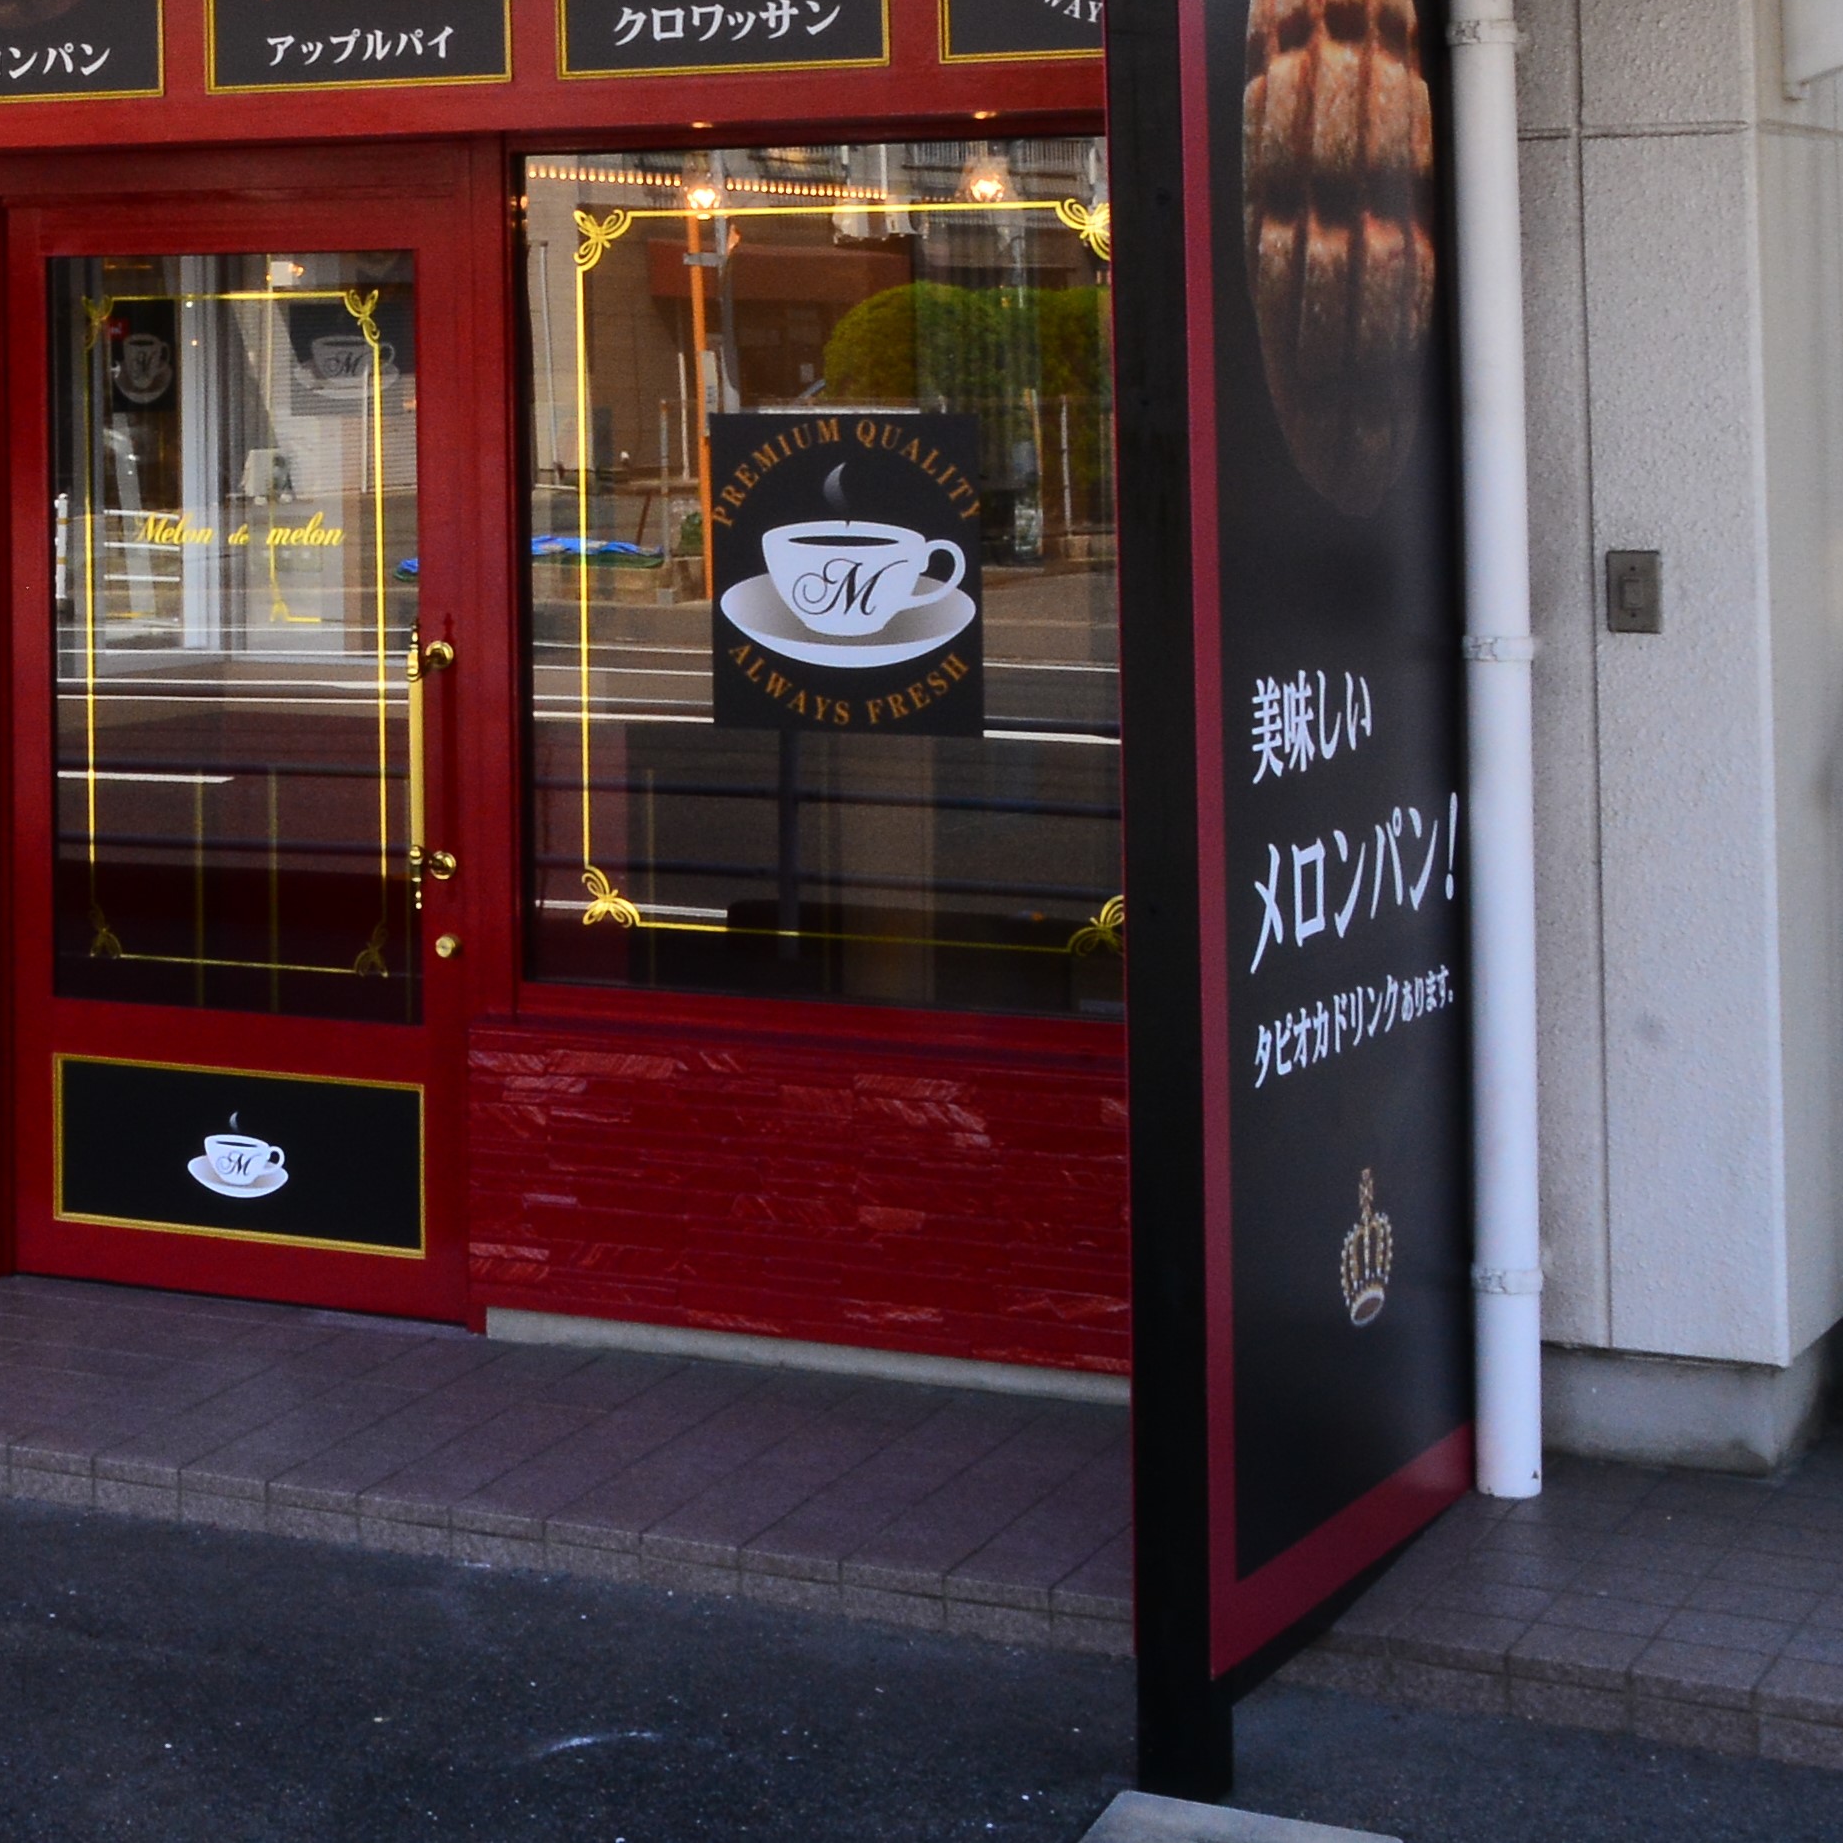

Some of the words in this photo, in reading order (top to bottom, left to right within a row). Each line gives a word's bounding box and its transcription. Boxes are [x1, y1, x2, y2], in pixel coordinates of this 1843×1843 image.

[265, 24, 455, 67] アップルパイ
[713, 417, 842, 528] PREMIUM
[855, 418, 982, 520] QUALITY
[134, 511, 213, 546] Melon
[227, 523, 250, 546] de
[265, 511, 345, 547] melon
[728, 642, 852, 725] ALWAYS
[865, 652, 971, 726] FRESH
[1250, 668, 1374, 786] 美味しい
[1249, 790, 1459, 975] メロンパン!
[1253, 963, 1456, 1090] タピオカドリンクあります。
